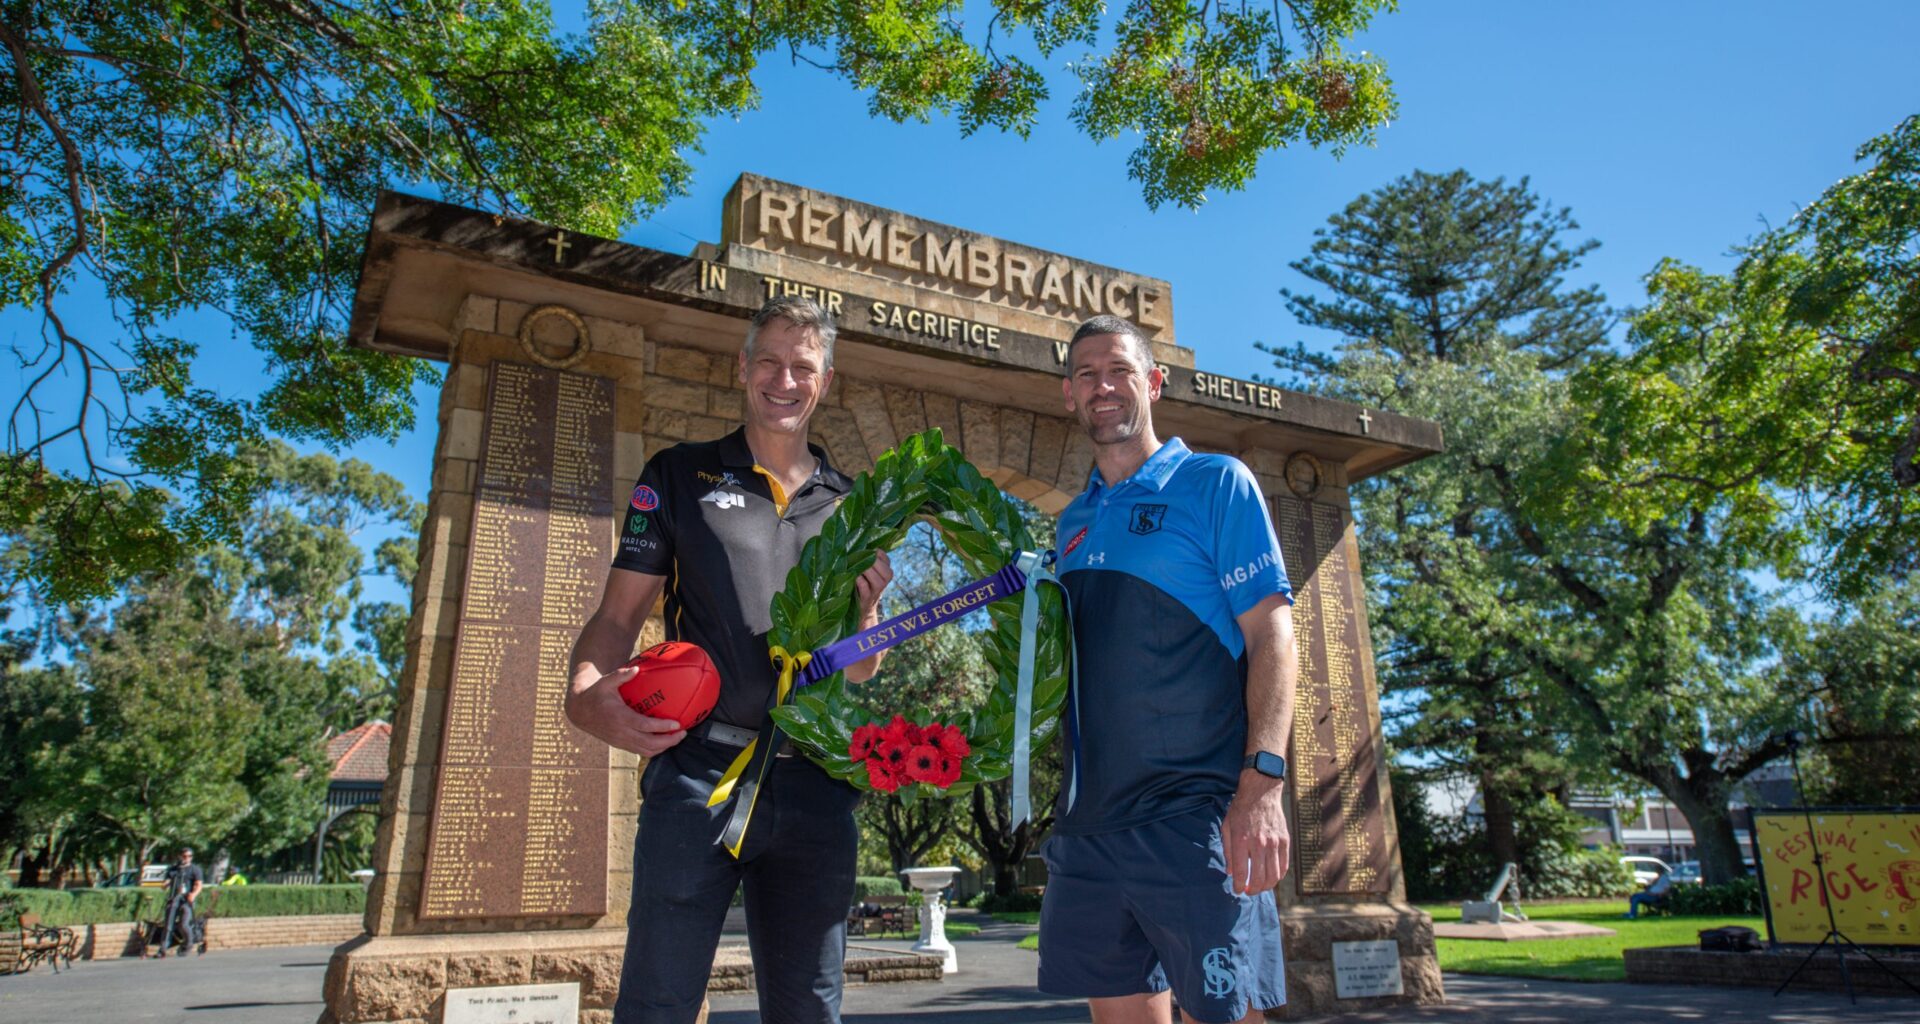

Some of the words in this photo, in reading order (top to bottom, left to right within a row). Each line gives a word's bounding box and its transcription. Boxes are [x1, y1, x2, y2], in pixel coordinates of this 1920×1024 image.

[758, 190, 1165, 331] REMEMBRANCE
[701, 260, 727, 291] IN
[764, 276, 843, 315] THEIR
[872, 302, 1000, 350] SACRIFICE
[1195, 372, 1282, 410] SHELTER
[856, 624, 899, 653] LEST
[898, 609, 932, 633] WE
[932, 582, 998, 620] FORGET
[1775, 830, 1857, 864] FESTIVAL
[1790, 862, 1879, 908] RICE
